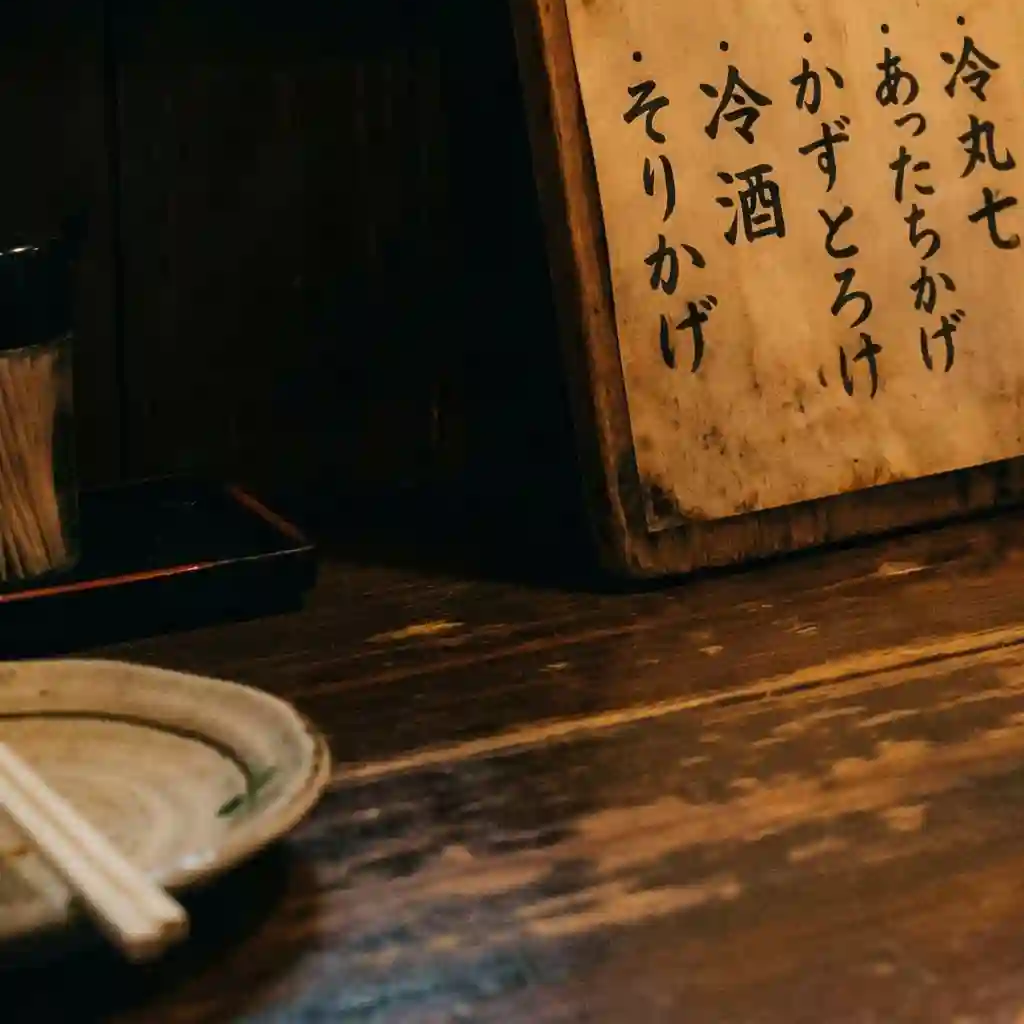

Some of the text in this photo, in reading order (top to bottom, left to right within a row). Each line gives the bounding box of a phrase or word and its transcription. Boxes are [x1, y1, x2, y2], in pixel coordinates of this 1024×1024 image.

[622, 79, 718, 373] そりかげ
[699, 64, 786, 246] 冷酒
[939, 35, 1021, 250] 冷丸七
